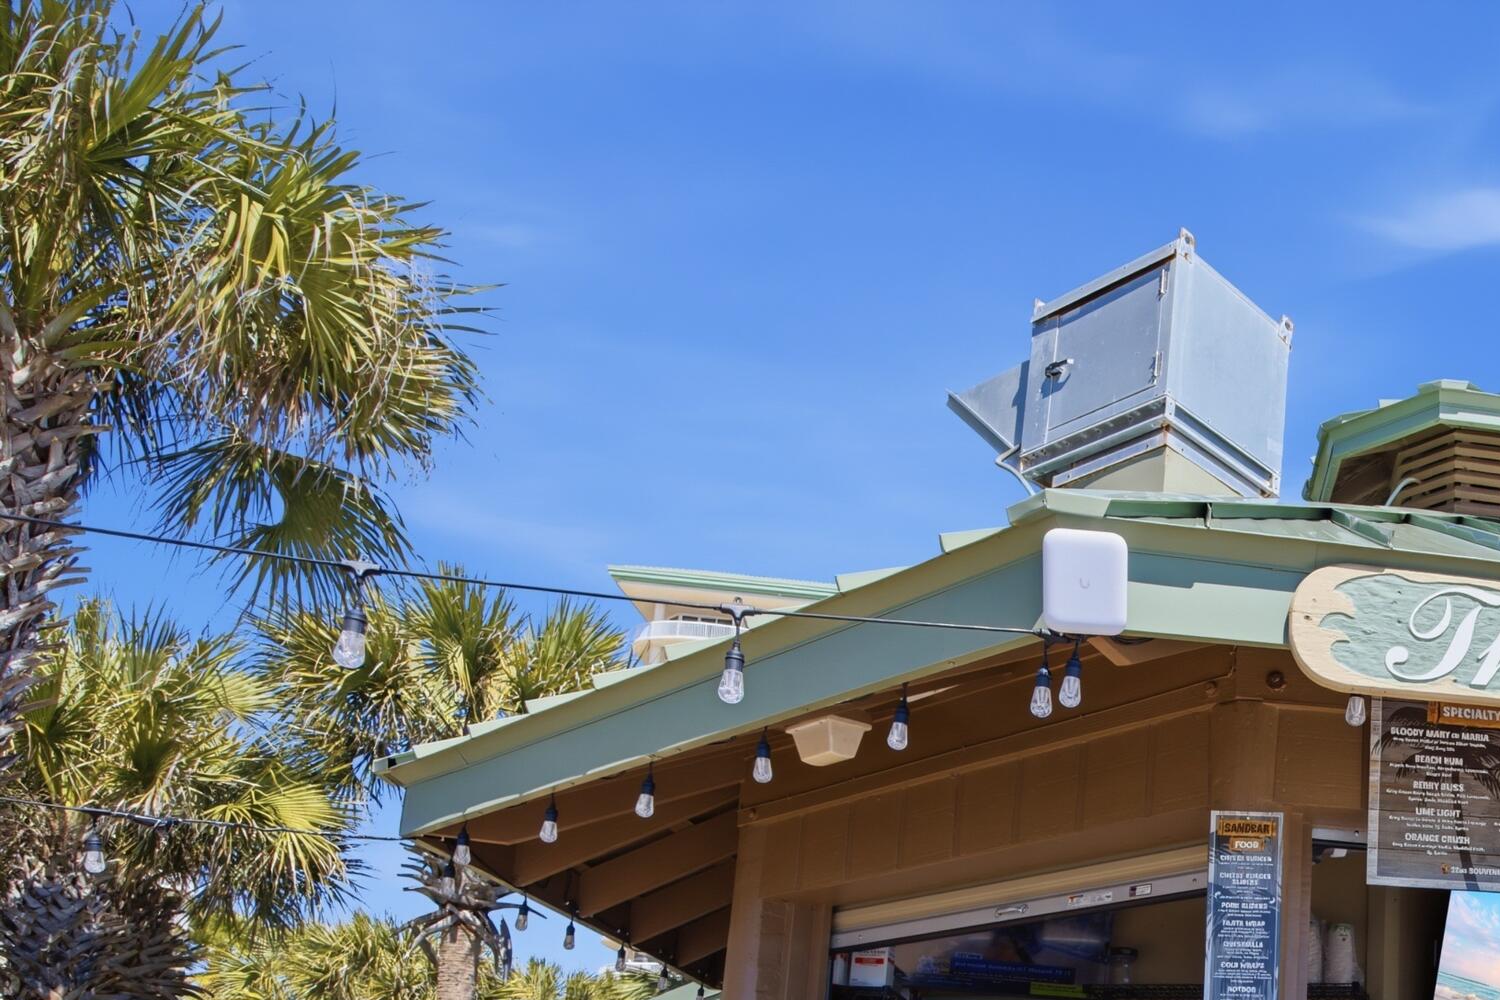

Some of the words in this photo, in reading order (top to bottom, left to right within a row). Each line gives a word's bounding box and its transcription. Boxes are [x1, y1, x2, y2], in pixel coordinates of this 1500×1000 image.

[1442, 706, 1500, 722] SPECIALTY
[1390, 727, 1424, 737] BLOODY
[1426, 729, 1451, 739] MARY
[1461, 732, 1489, 742] MARIA
[1415, 754, 1442, 765] BEACH
[1413, 781, 1440, 791] BERRY
[1416, 807, 1435, 817] LIME
[1437, 809, 1462, 818] LIGHT
[1224, 823, 1270, 834] SANDBAR
[1405, 833, 1439, 843] ORANGE
[1441, 835, 1471, 845] CRUSH
[1235, 841, 1259, 849] FOOD
